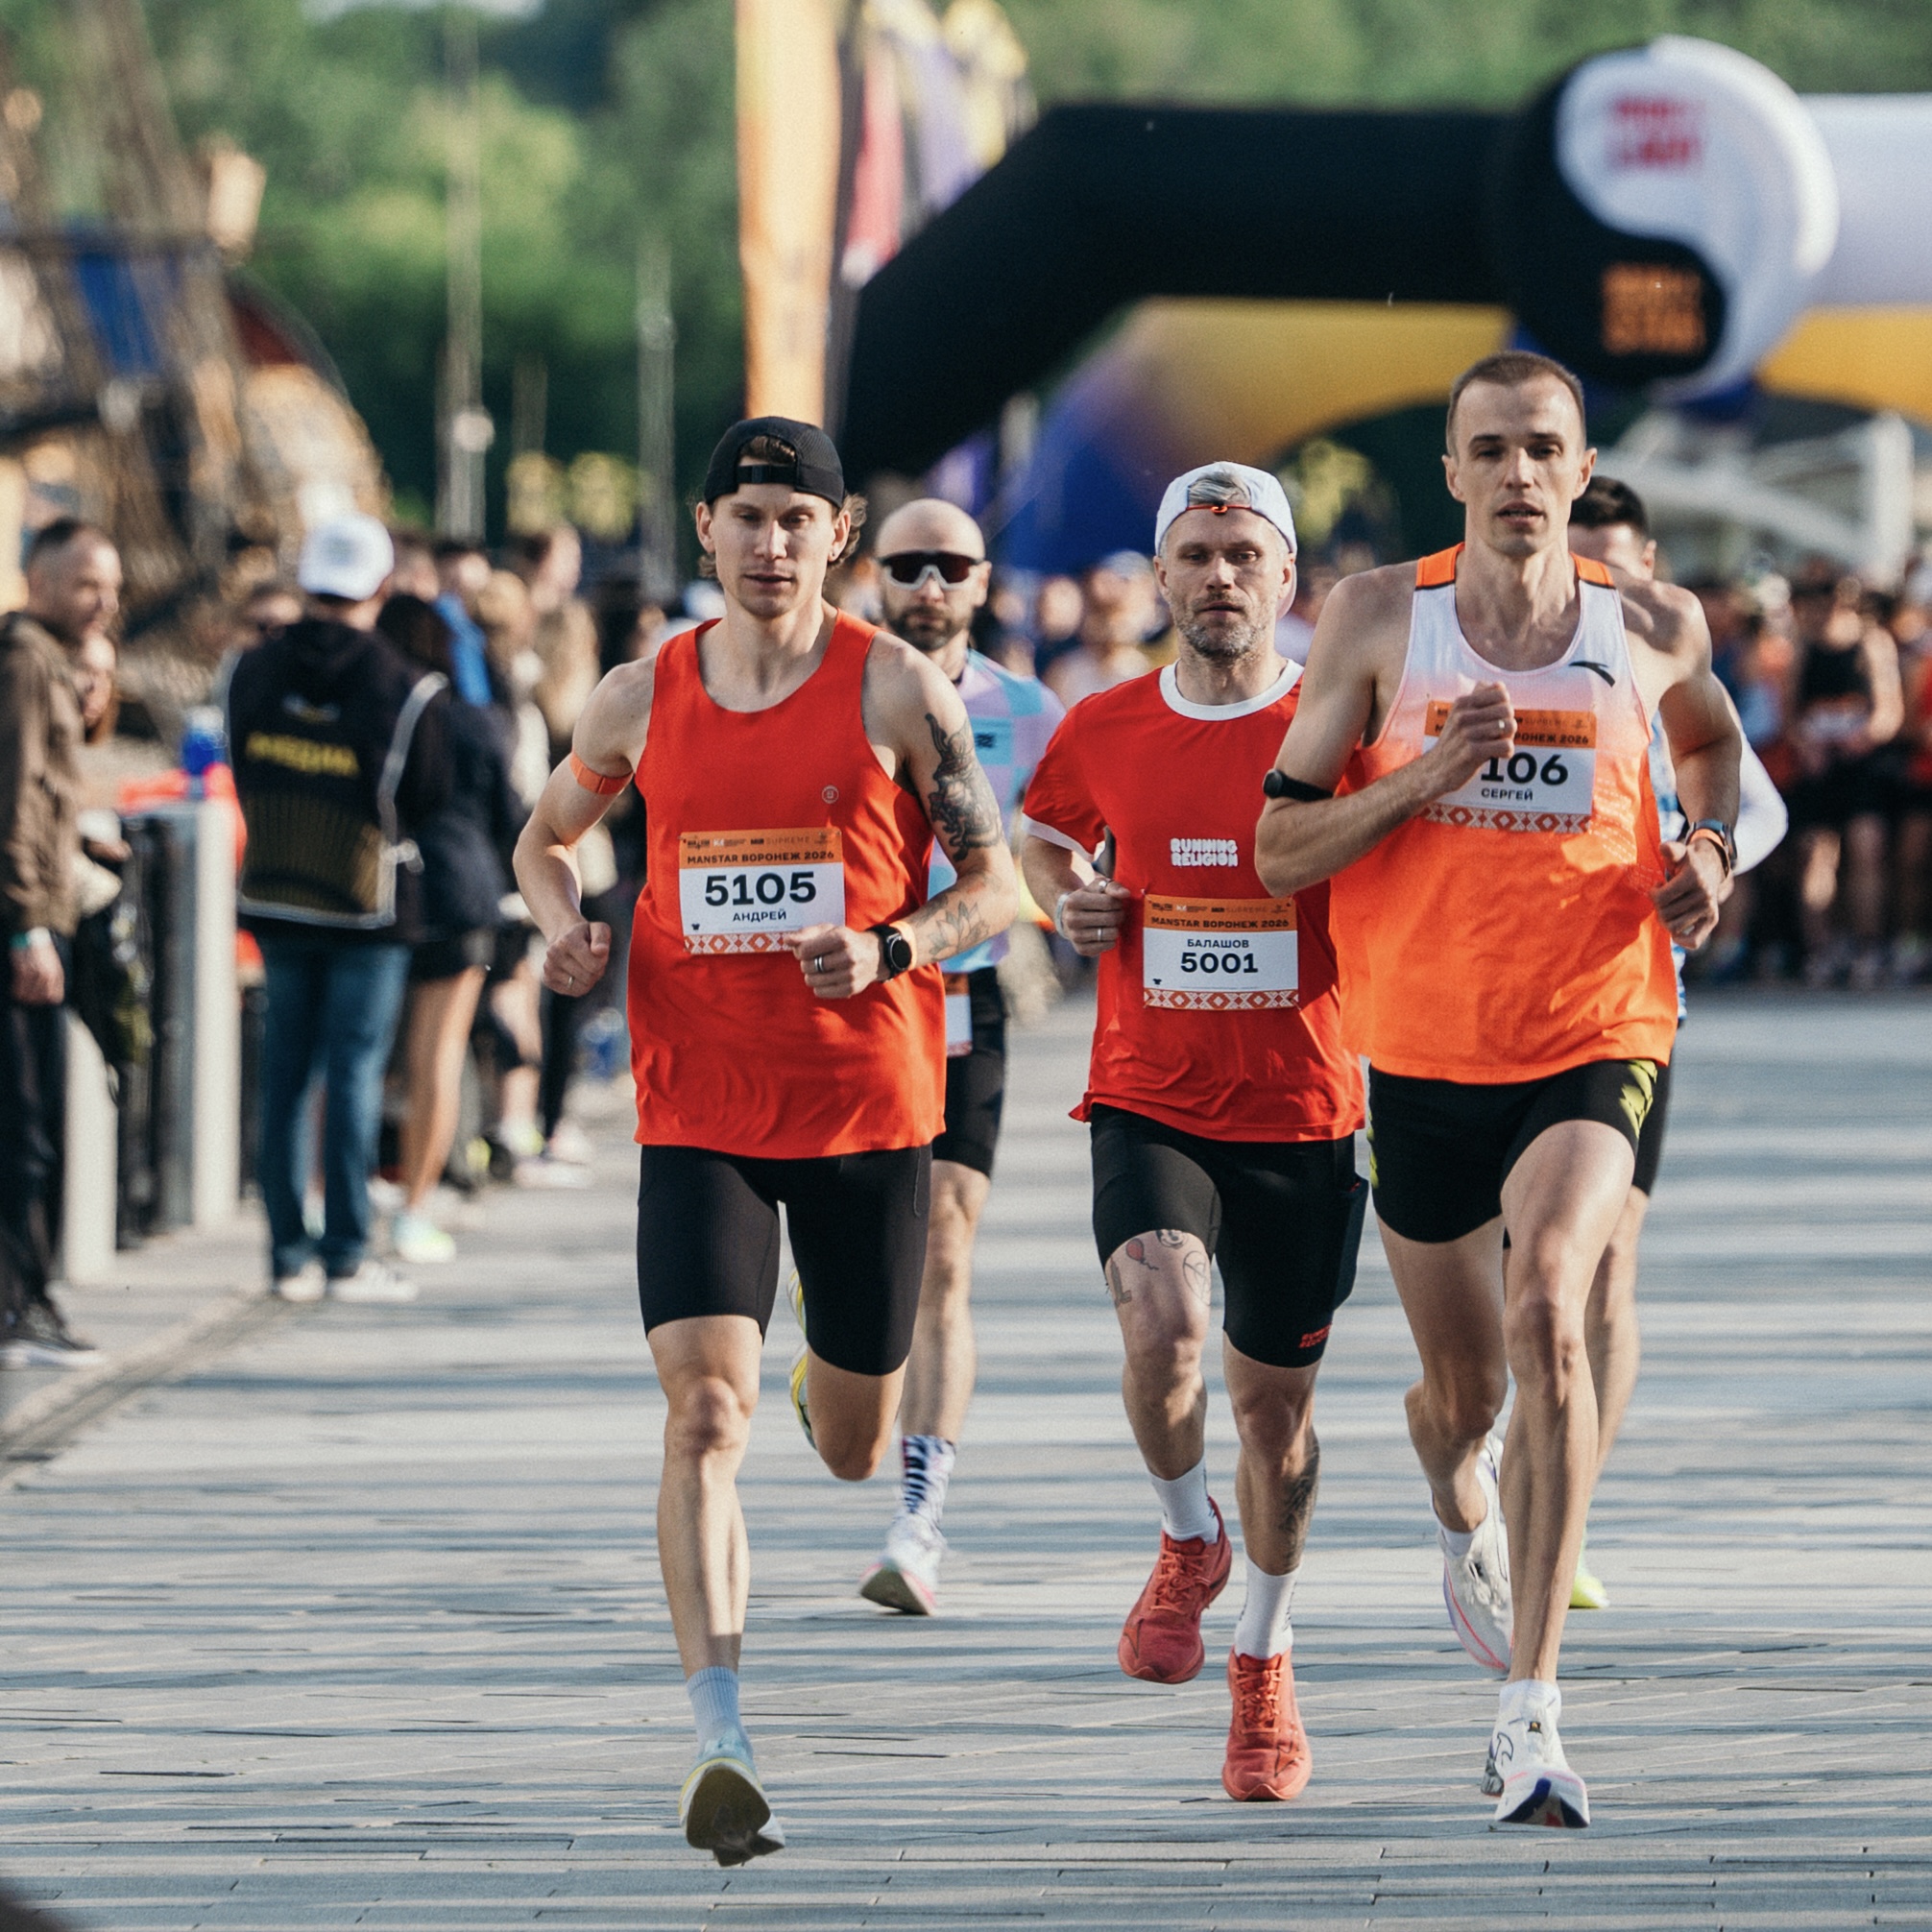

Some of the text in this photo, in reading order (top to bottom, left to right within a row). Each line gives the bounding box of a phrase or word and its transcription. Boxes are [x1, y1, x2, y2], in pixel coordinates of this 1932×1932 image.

[1514, 732, 1588, 744] РОНЕЖ 2026
[1481, 752, 1568, 785] 106
[1481, 787, 1534, 801] СЕРГЕЙ
[688, 851, 834, 864] MANSTAR ВОРОНЕЖ 2026
[1171, 852, 1239, 867] RELIGION
[705, 871, 816, 906] 5105
[733, 908, 786, 923] АНДРЕЙ
[1151, 917, 1289, 929] MANSTAR ВОРОНЕЖ 2026
[1187, 938, 1249, 949] БАЛАШОВ
[1180, 952, 1258, 974] 5001
